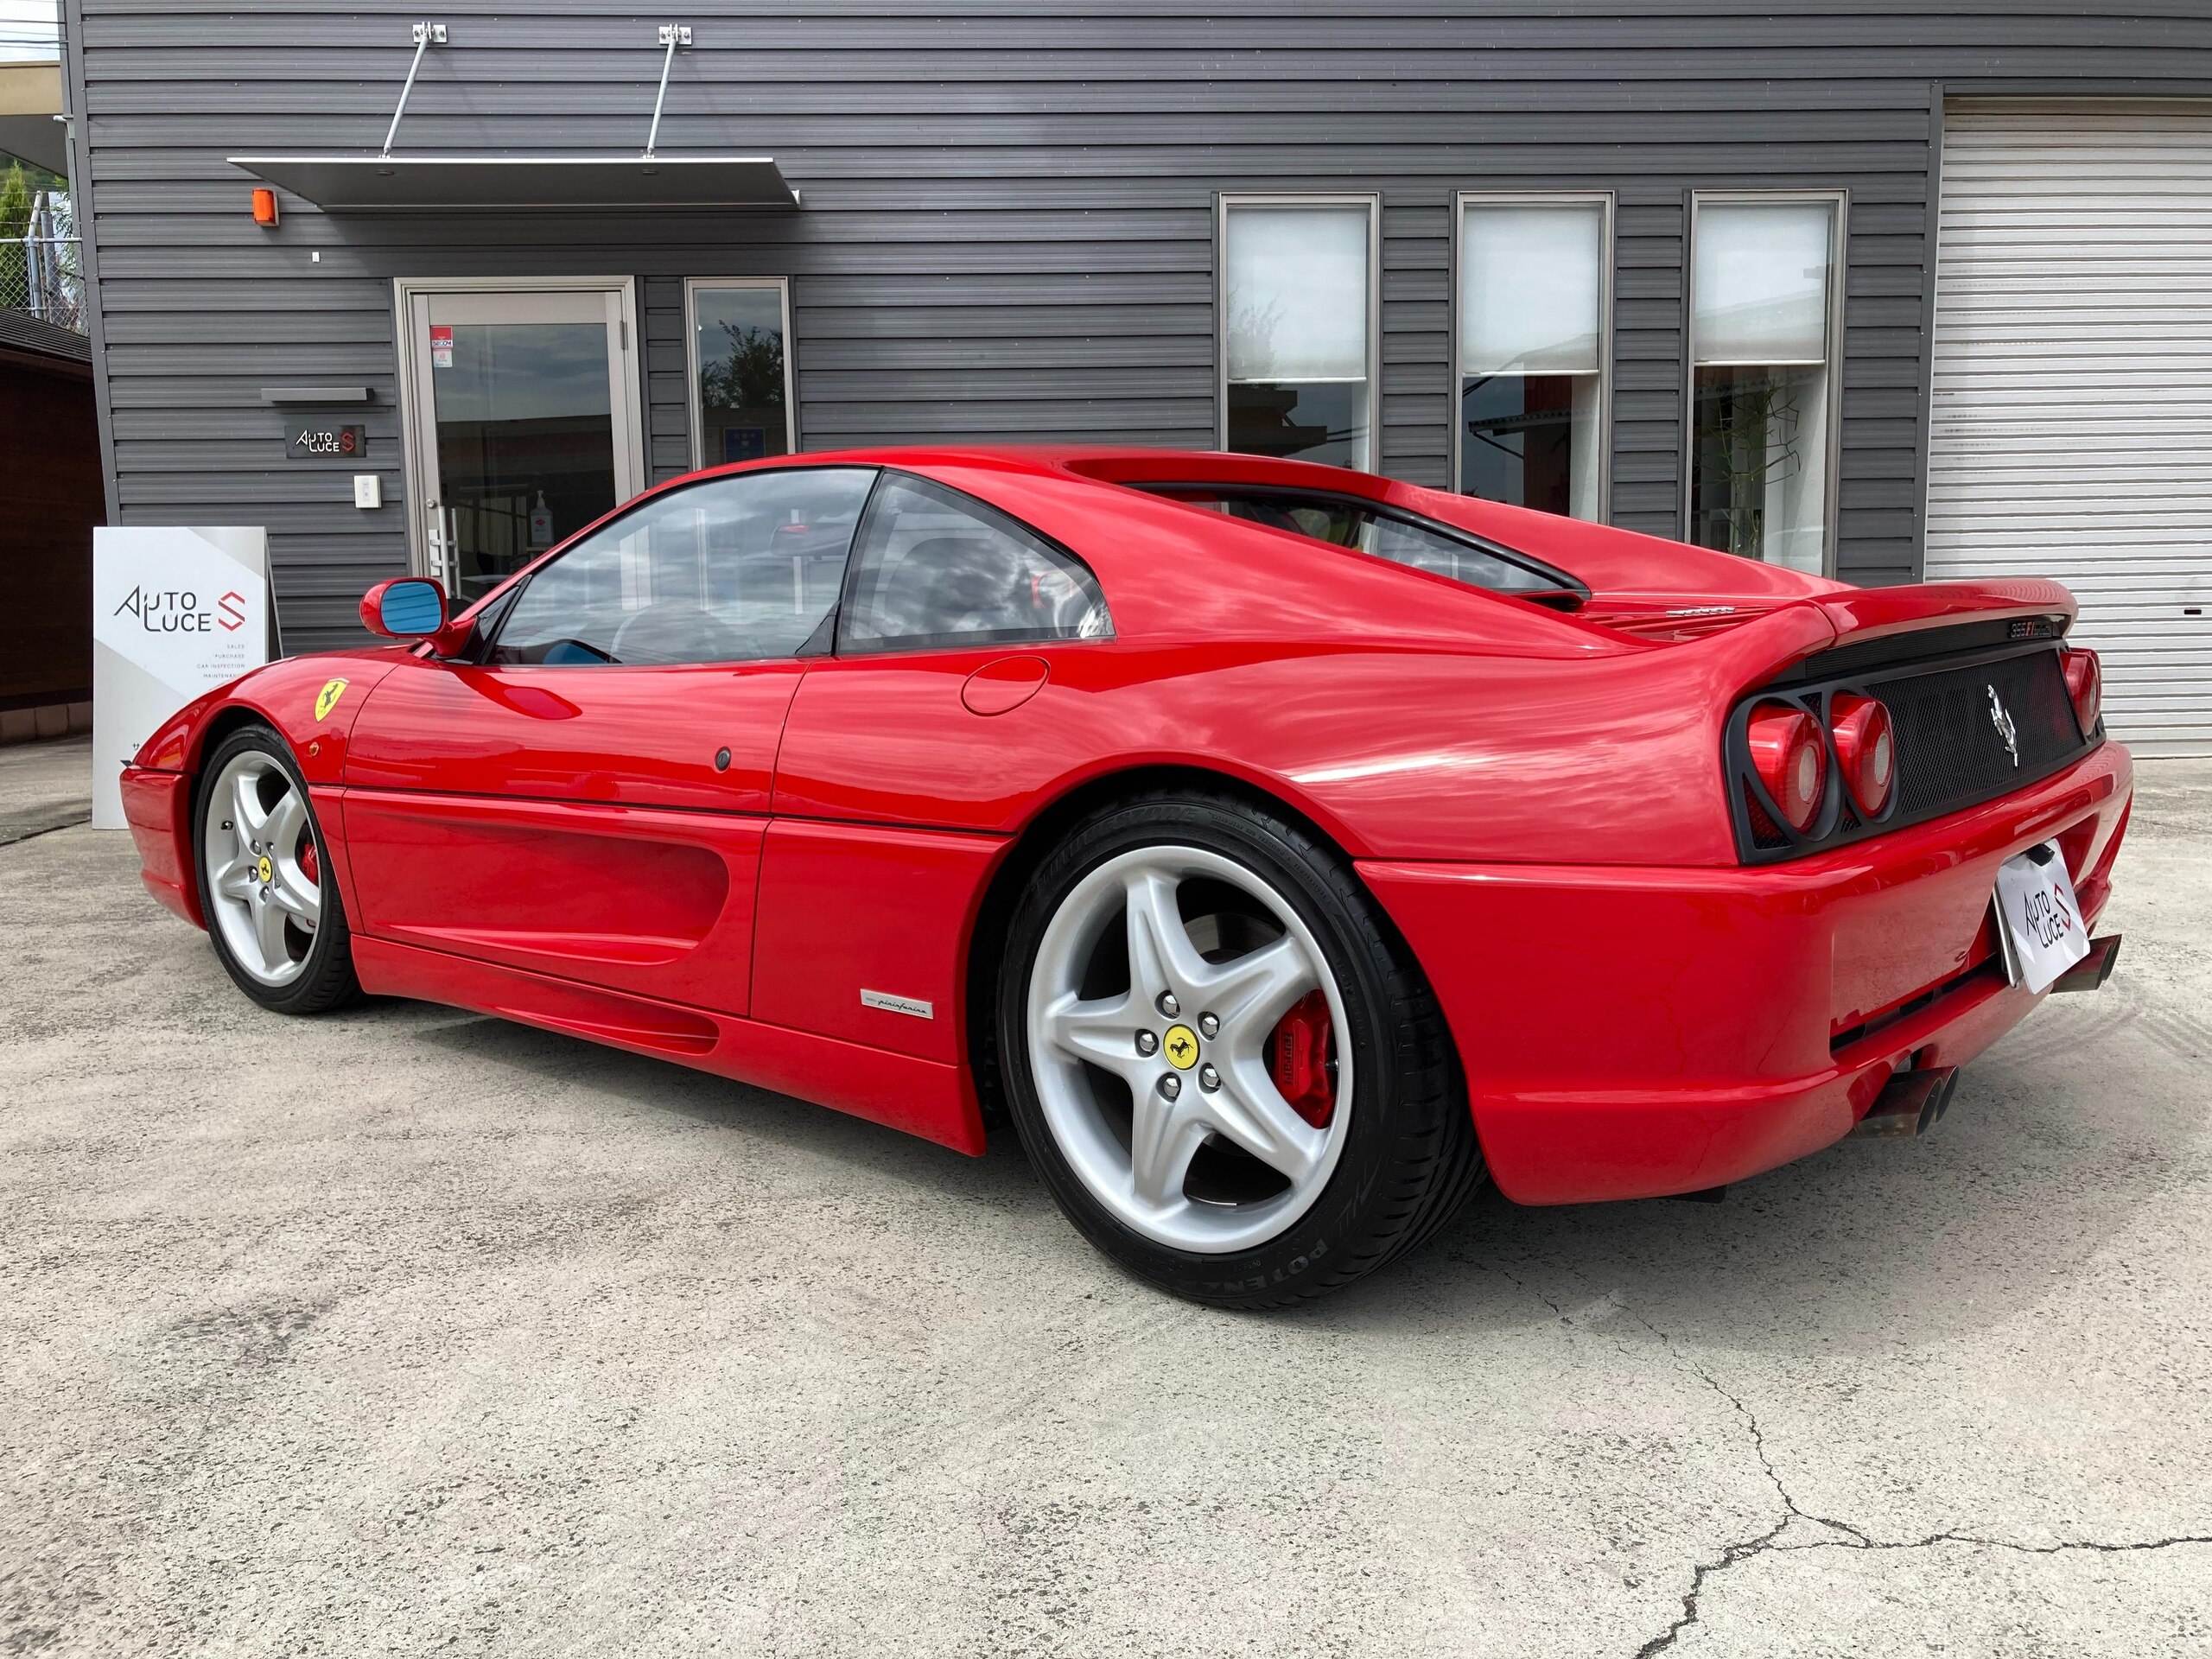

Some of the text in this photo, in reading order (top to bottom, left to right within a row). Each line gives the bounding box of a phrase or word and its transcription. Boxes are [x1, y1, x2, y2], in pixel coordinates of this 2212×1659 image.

[296, 429, 333, 446] AUTO
[308, 431, 355, 452] LUCE S
[113, 584, 197, 619] AUTO
[143, 590, 245, 632] LUCE S
[2023, 889, 2051, 937] AUTO
[2036, 912, 2064, 950] LUCE
